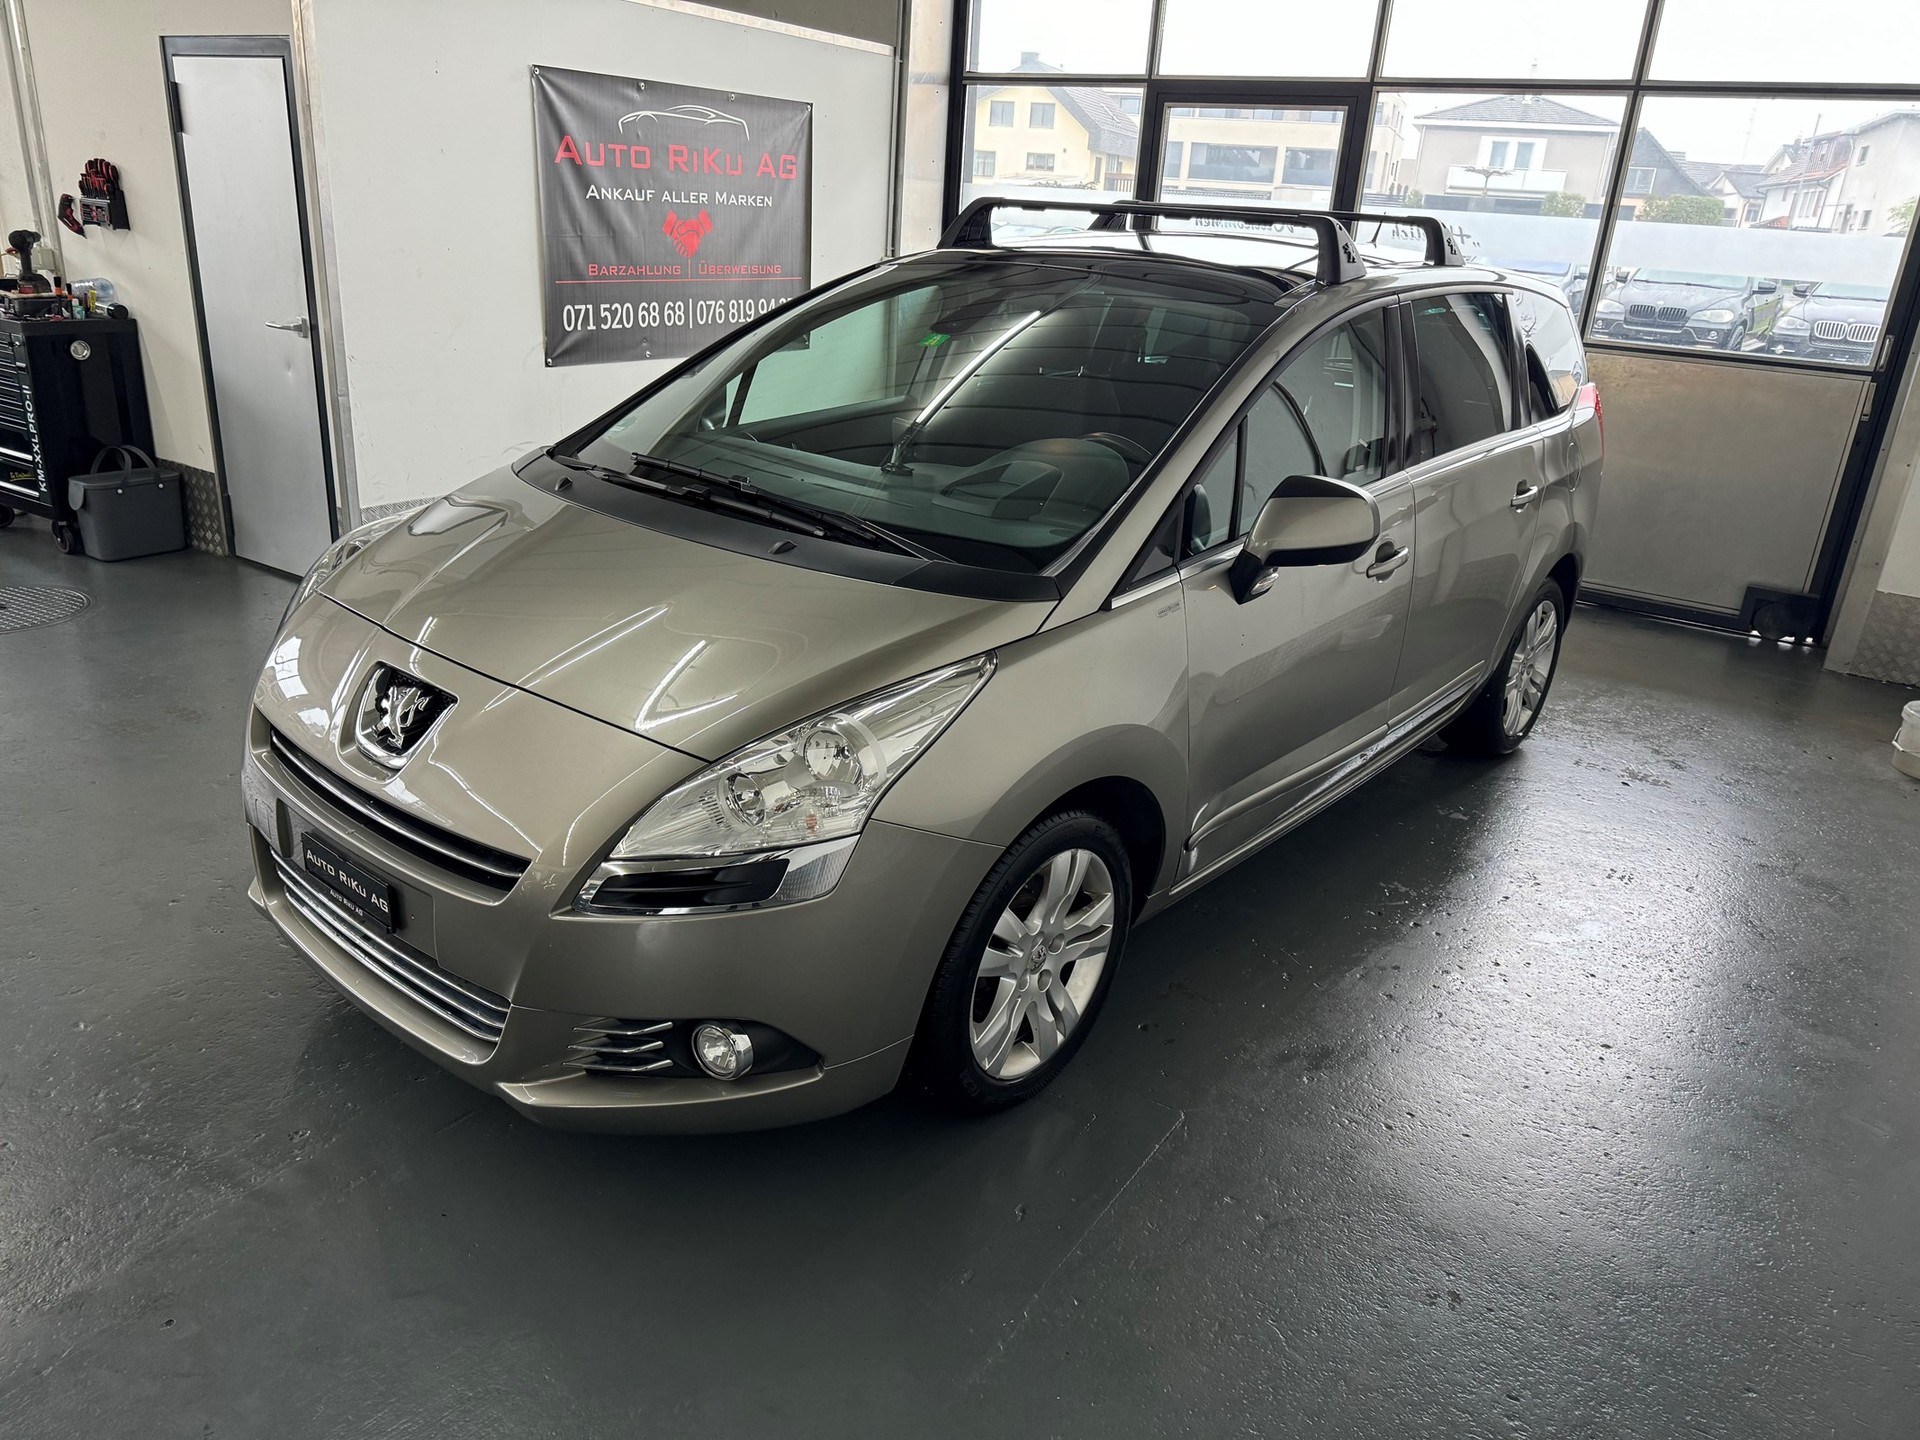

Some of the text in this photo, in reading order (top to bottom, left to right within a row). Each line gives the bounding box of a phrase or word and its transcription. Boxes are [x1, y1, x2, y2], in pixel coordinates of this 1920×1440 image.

[554, 135, 651, 170] AUTO
[756, 152, 798, 180] AG
[586, 184, 773, 208] ANKAUF ALLER MARKEN
[588, 260, 782, 277] BARZAHLUNG ÜBERWEISUNG
[562, 304, 597, 332] 071
[600, 302, 634, 331] 520
[637, 301, 660, 329] 68
[663, 300, 685, 327] 68
[696, 298, 725, 326] 076
[728, 298, 755, 324] 819
[306, 849, 335, 876] AUTO
[371, 893, 389, 913] AG
